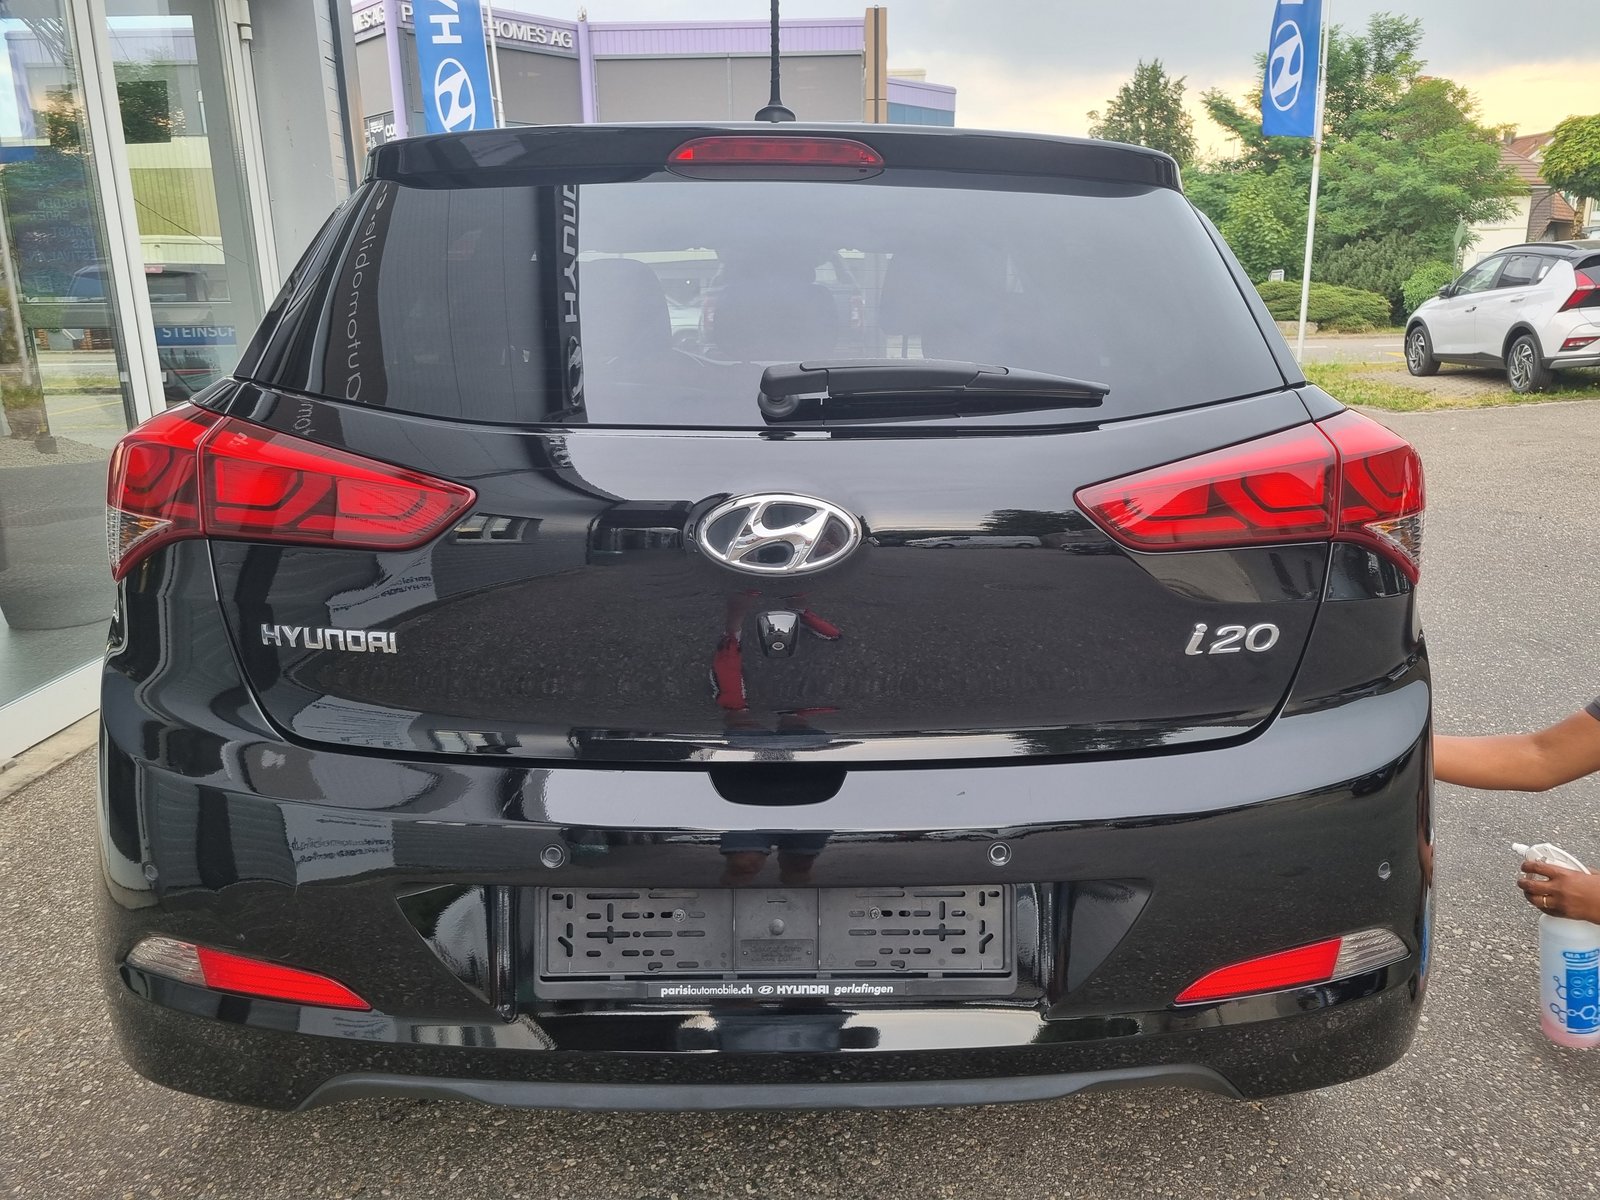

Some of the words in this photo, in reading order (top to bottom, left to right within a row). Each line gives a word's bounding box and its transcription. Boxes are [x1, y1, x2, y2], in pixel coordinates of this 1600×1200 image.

[492, 20, 547, 44] HOMES
[550, 30, 573, 48] AG
[260, 623, 398, 653] HYUNDAI
[1184, 623, 1280, 655] i20
[660, 984, 753, 998] parisiautomobile.ch
[776, 984, 830, 995] HYUNDAI
[834, 984, 894, 996] gerlafingen
